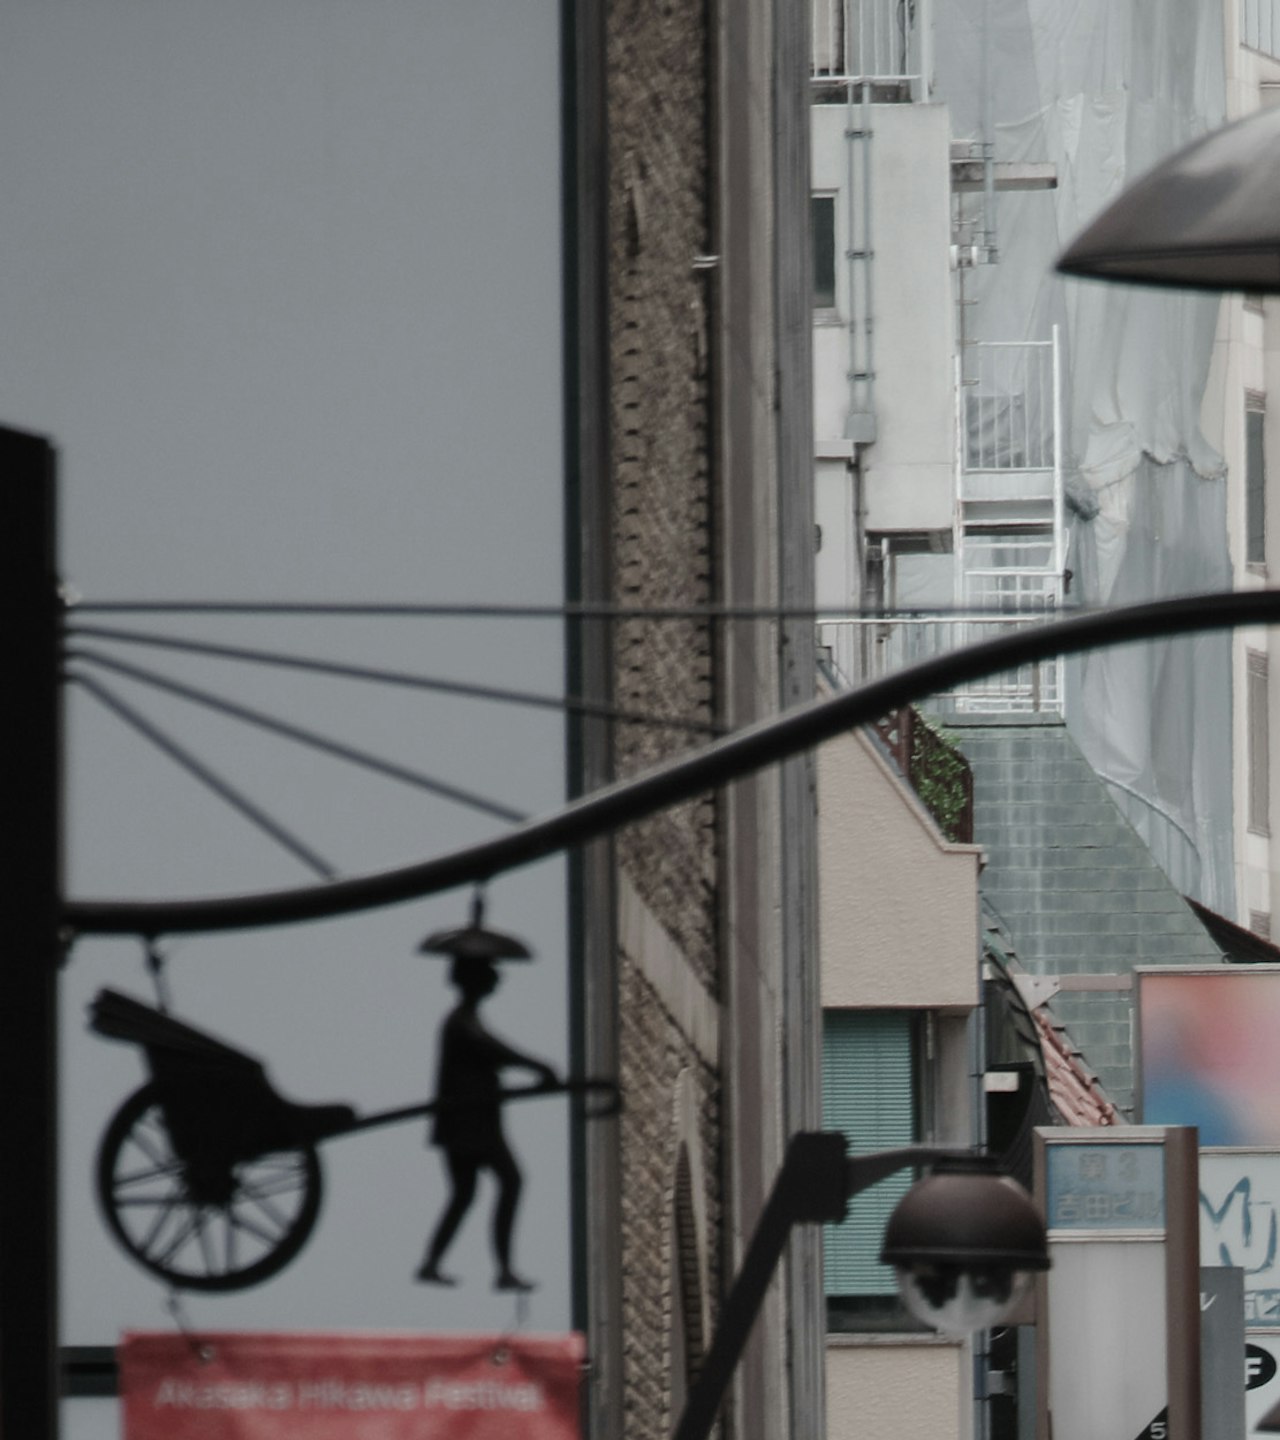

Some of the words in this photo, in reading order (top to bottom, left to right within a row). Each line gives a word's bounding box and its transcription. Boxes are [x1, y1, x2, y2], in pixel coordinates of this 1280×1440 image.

[155, 1379, 295, 1410] Akasaka
[299, 1379, 419, 1411] Hikawa
[423, 1378, 545, 1412] Festival
[1150, 1422, 1166, 1440] 5
